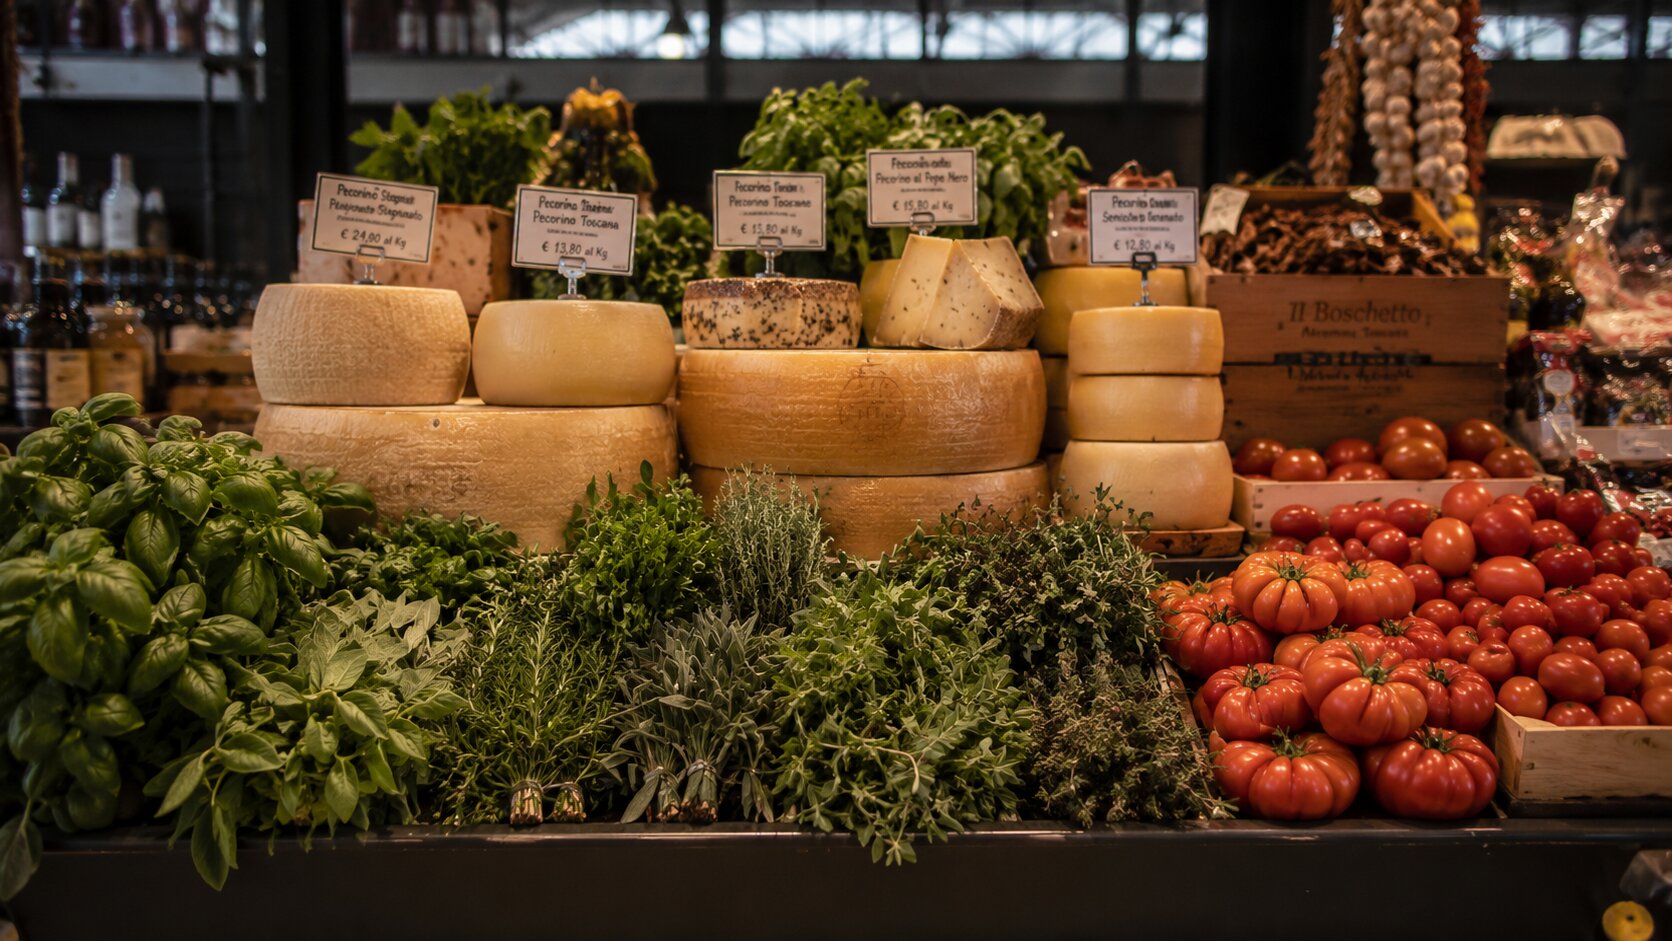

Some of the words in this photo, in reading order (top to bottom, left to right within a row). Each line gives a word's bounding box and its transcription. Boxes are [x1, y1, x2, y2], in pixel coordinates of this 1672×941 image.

[538, 195, 578, 211] Pecorino
[942, 201, 953, 213] Kg
[532, 210, 576, 225] Pecorino
[791, 225, 803, 238] Kg
[340, 229, 349, 240] €
[383, 236, 393, 245] al
[394, 237, 407, 250] Kg
[541, 241, 549, 252] €
[555, 242, 582, 256] 13,80
[584, 247, 593, 256] al
[596, 247, 608, 261] Kg
[1164, 241, 1176, 254] Kg
[1314, 300, 1422, 323] Boschetto
